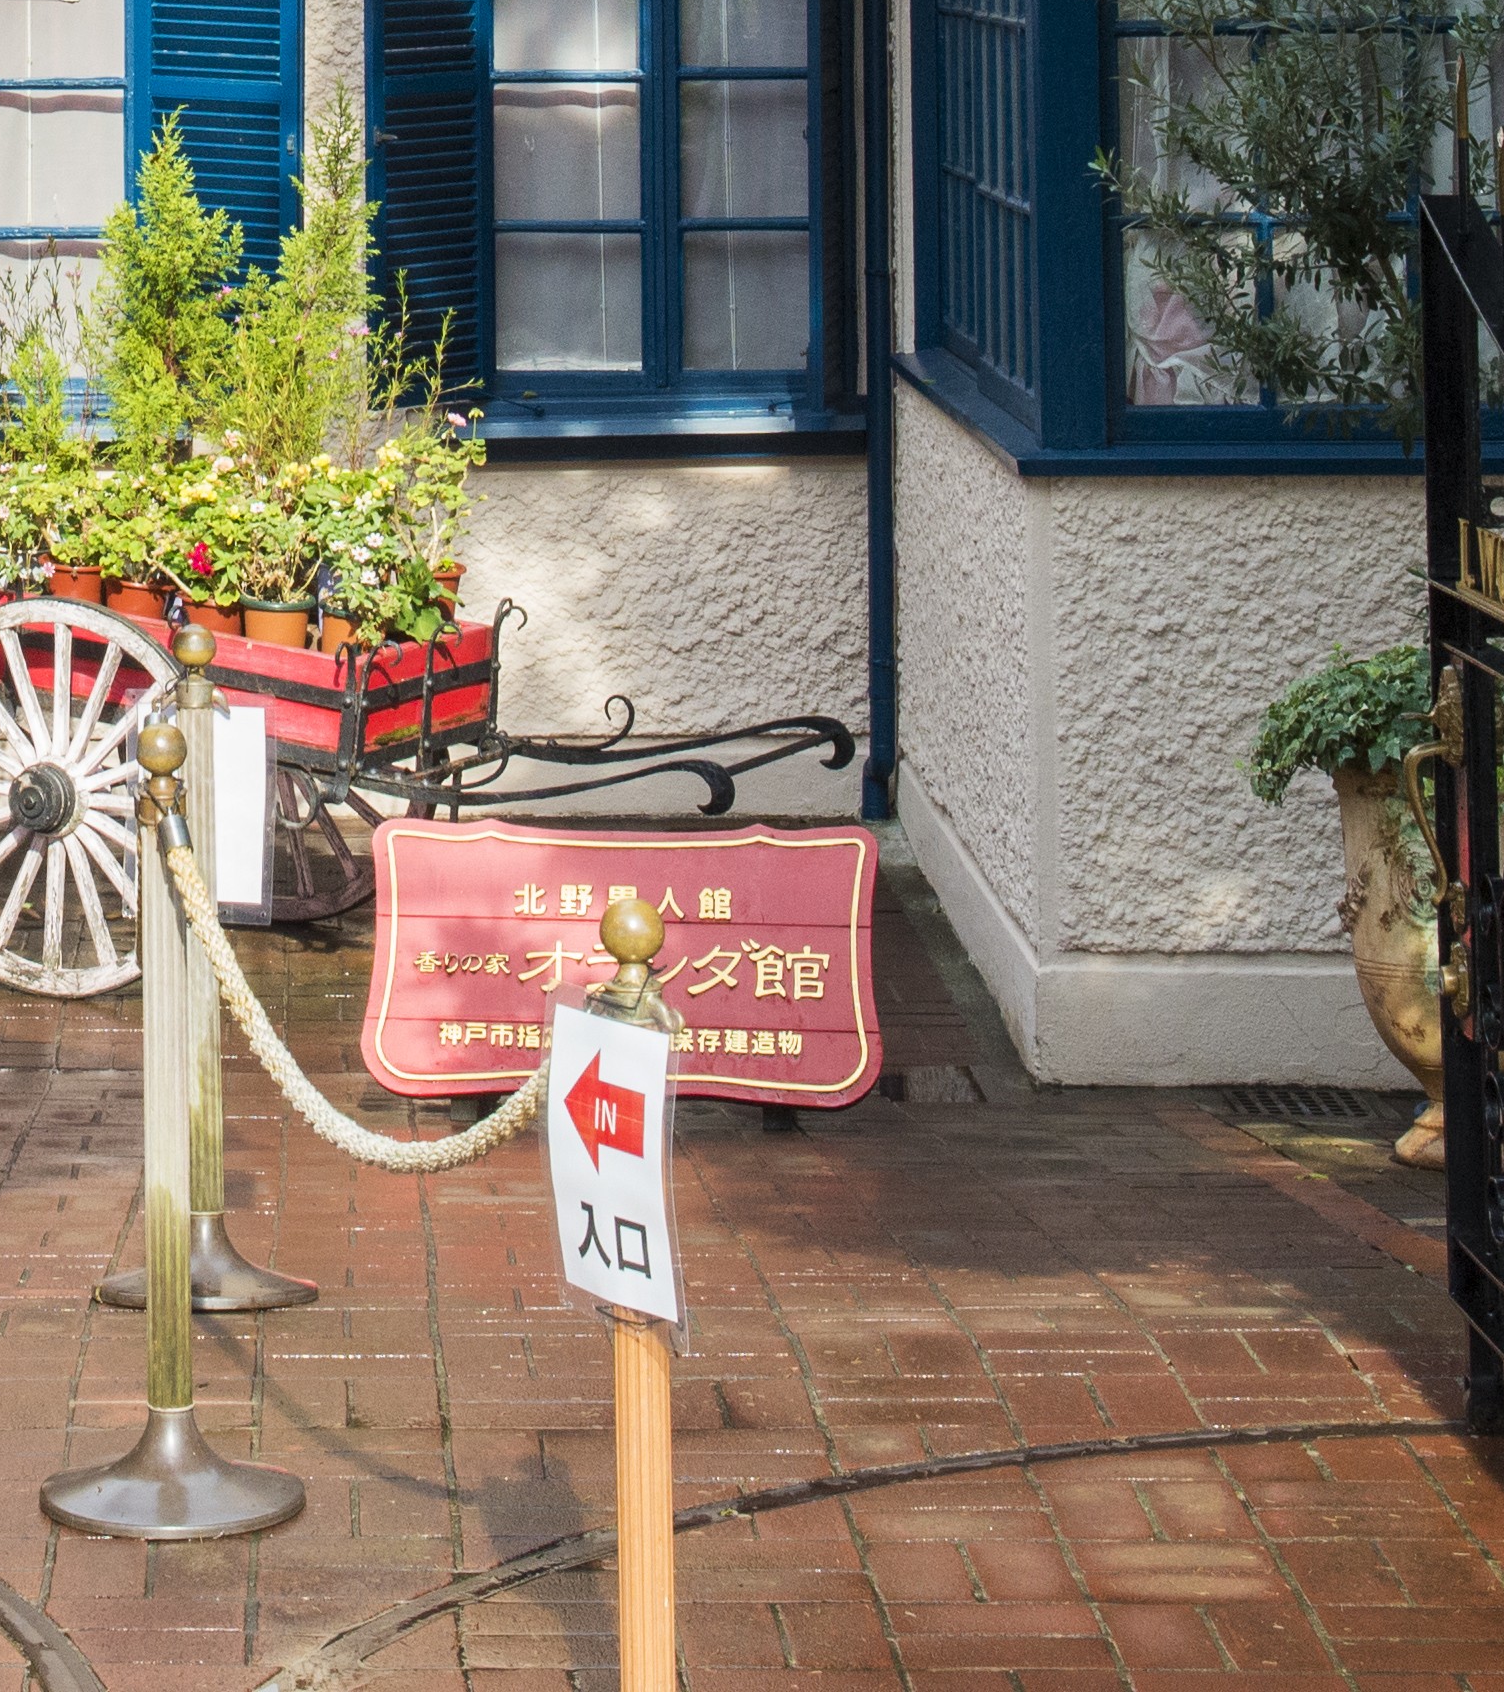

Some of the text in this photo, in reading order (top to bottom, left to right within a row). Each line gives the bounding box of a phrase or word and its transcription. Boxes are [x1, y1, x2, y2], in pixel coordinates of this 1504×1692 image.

[413, 950, 511, 975] 香りの家
[593, 1096, 618, 1136] IN
[577, 1201, 653, 1281] 入口
